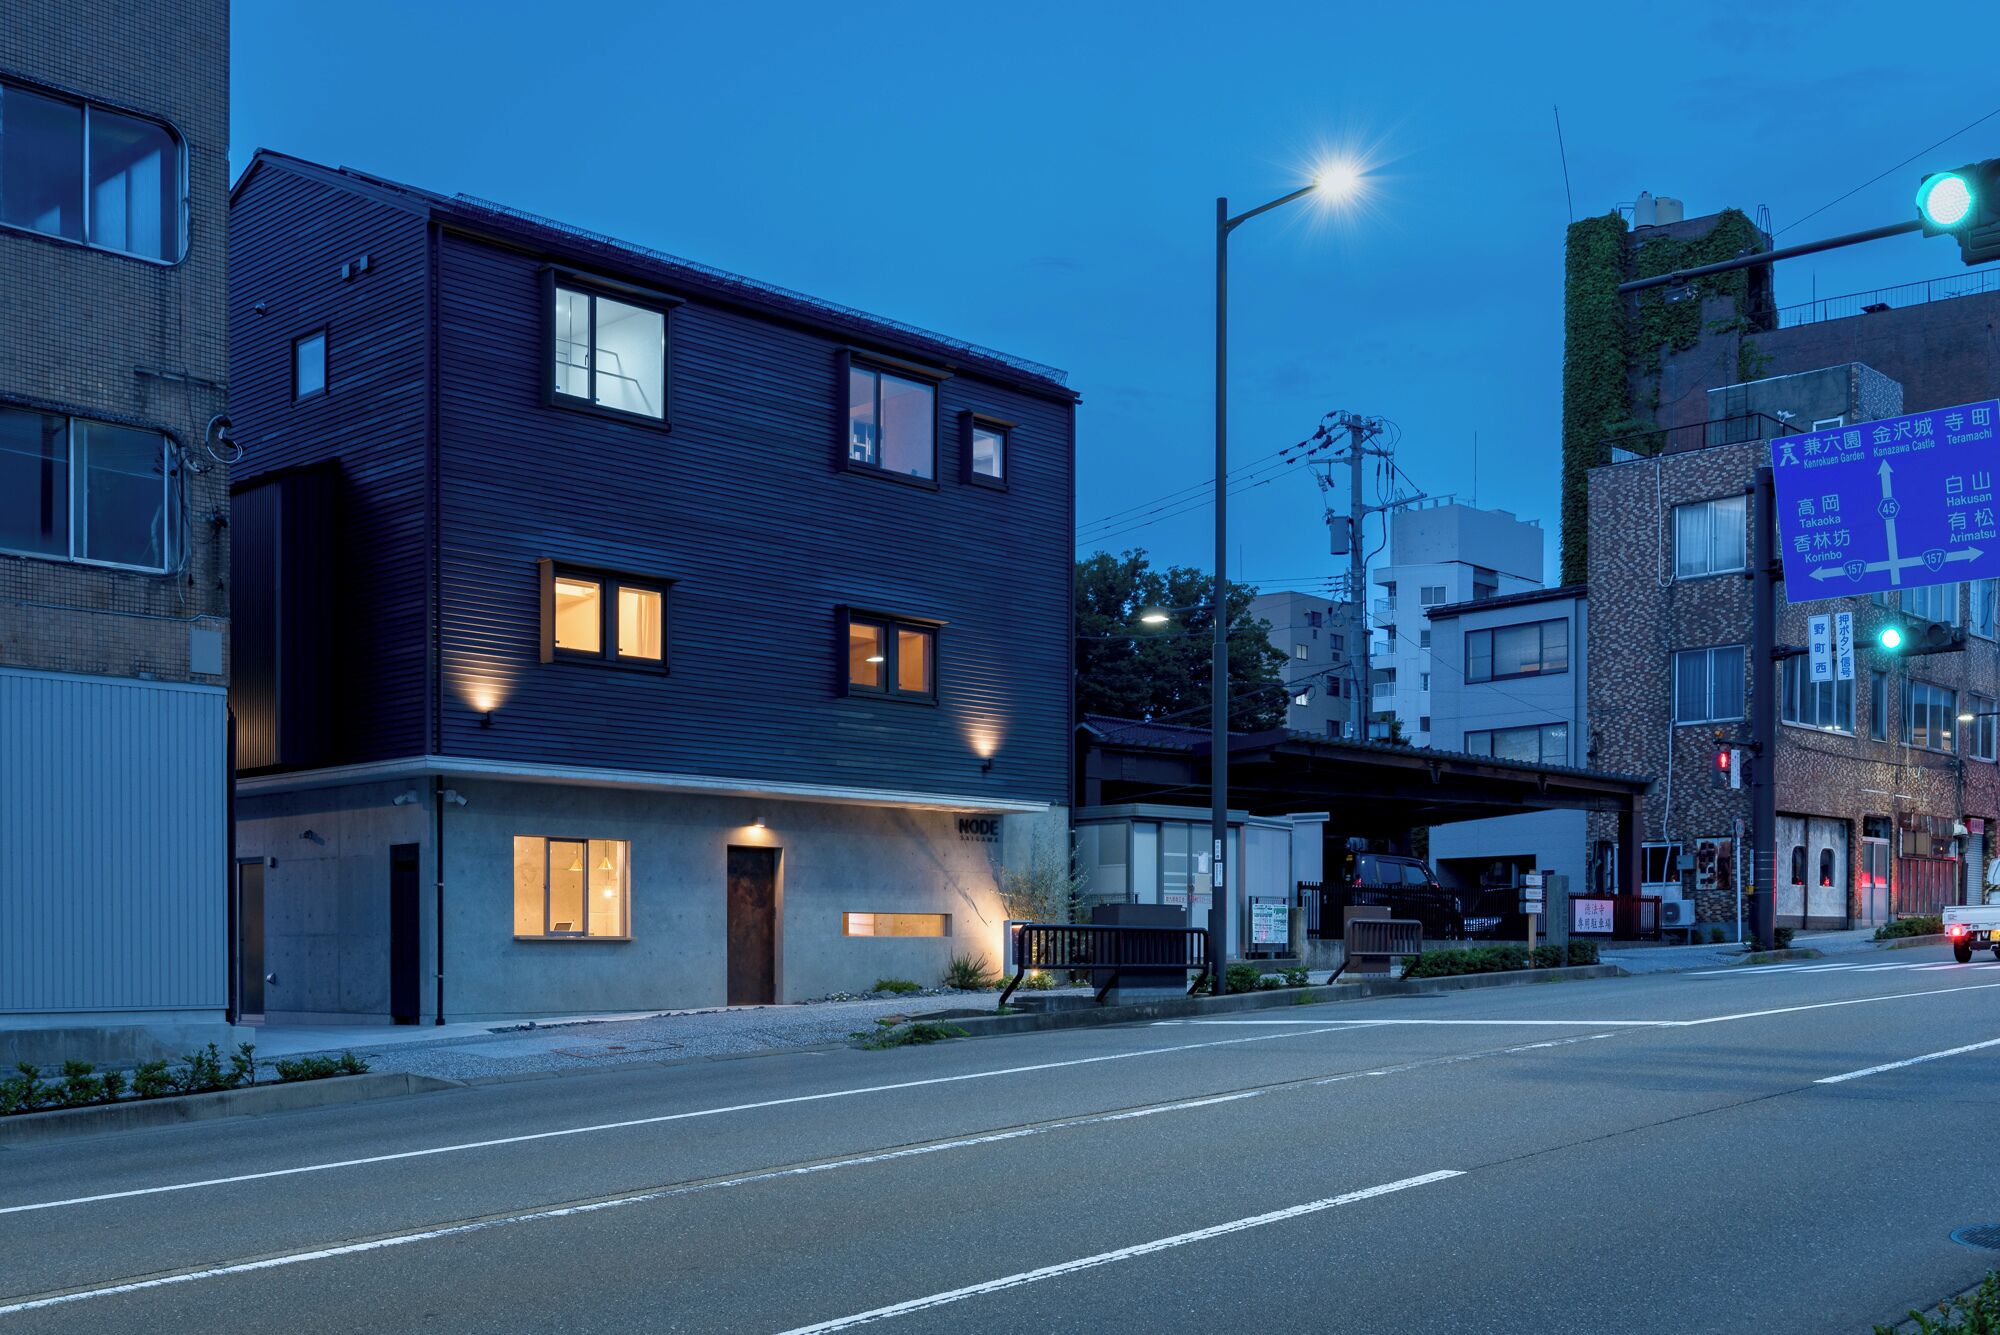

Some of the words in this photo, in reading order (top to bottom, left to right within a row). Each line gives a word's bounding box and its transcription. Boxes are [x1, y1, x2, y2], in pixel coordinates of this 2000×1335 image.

[1944, 408, 1991, 432] 寺町
[1872, 417, 1934, 445] 金沢城
[1946, 429, 1993, 445] Teramachi
[1804, 430, 1862, 456] 兼六園
[1873, 444, 1910, 457] Kanazawa
[1912, 439, 1935, 451] Castle
[1803, 457, 1839, 469] Kenrokuen
[1840, 451, 1865, 463] Garden
[1946, 472, 1990, 494] 白山
[1798, 494, 1840, 517] 高岡
[1882, 503, 1896, 514] 45
[1946, 493, 1992, 508] Hakusan
[1799, 516, 1841, 528] Takaoka
[1948, 508, 1994, 531] 有松
[1794, 529, 1849, 553] 香林坊
[1949, 529, 1996, 543] Arimatsu
[1805, 550, 1842, 563] Korinbo
[1926, 553, 1942, 564] 157
[1847, 564, 1862, 574] 157
[1814, 624, 1826, 673] 野町西
[959, 819, 999, 835] NODE
